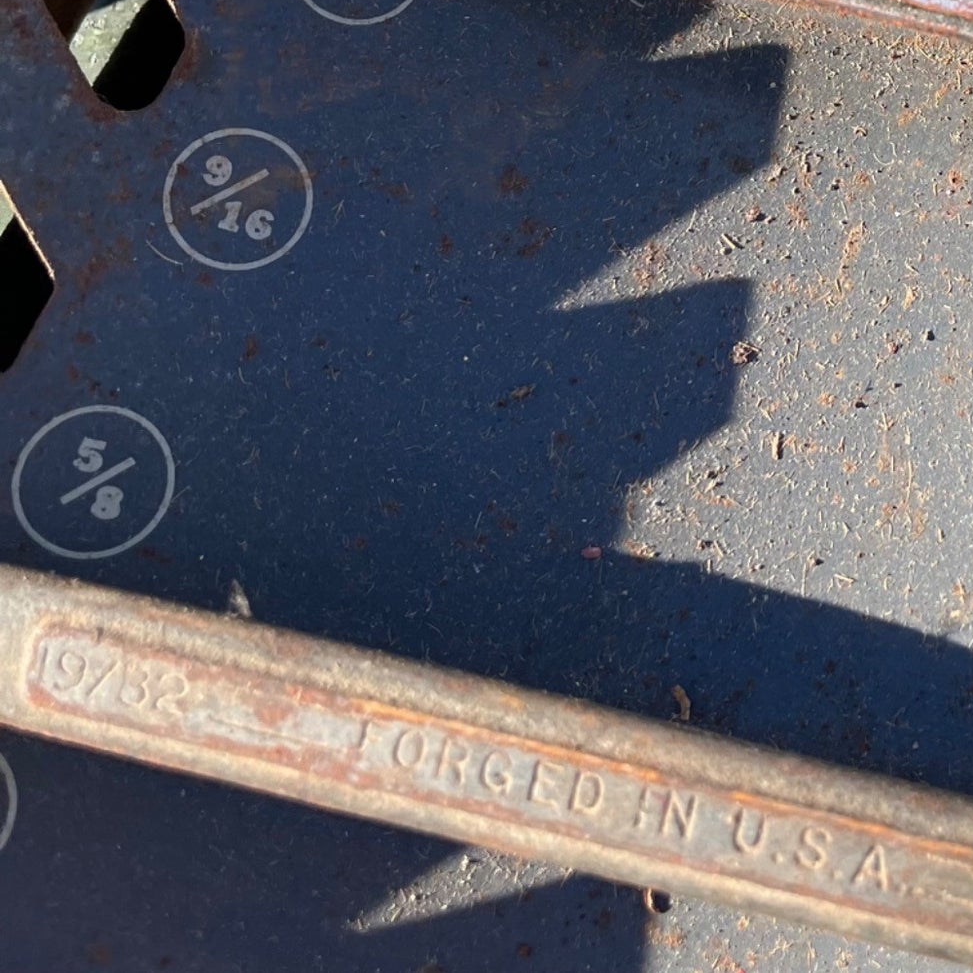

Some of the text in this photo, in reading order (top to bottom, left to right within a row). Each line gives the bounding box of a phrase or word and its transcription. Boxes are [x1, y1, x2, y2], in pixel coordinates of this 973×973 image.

[190, 155, 275, 240] 9/16
[59, 436, 137, 520] 5/8
[35, 643, 191, 717] 19/32
[354, 718, 606, 817] FORGED
[635, 782, 698, 840] IN
